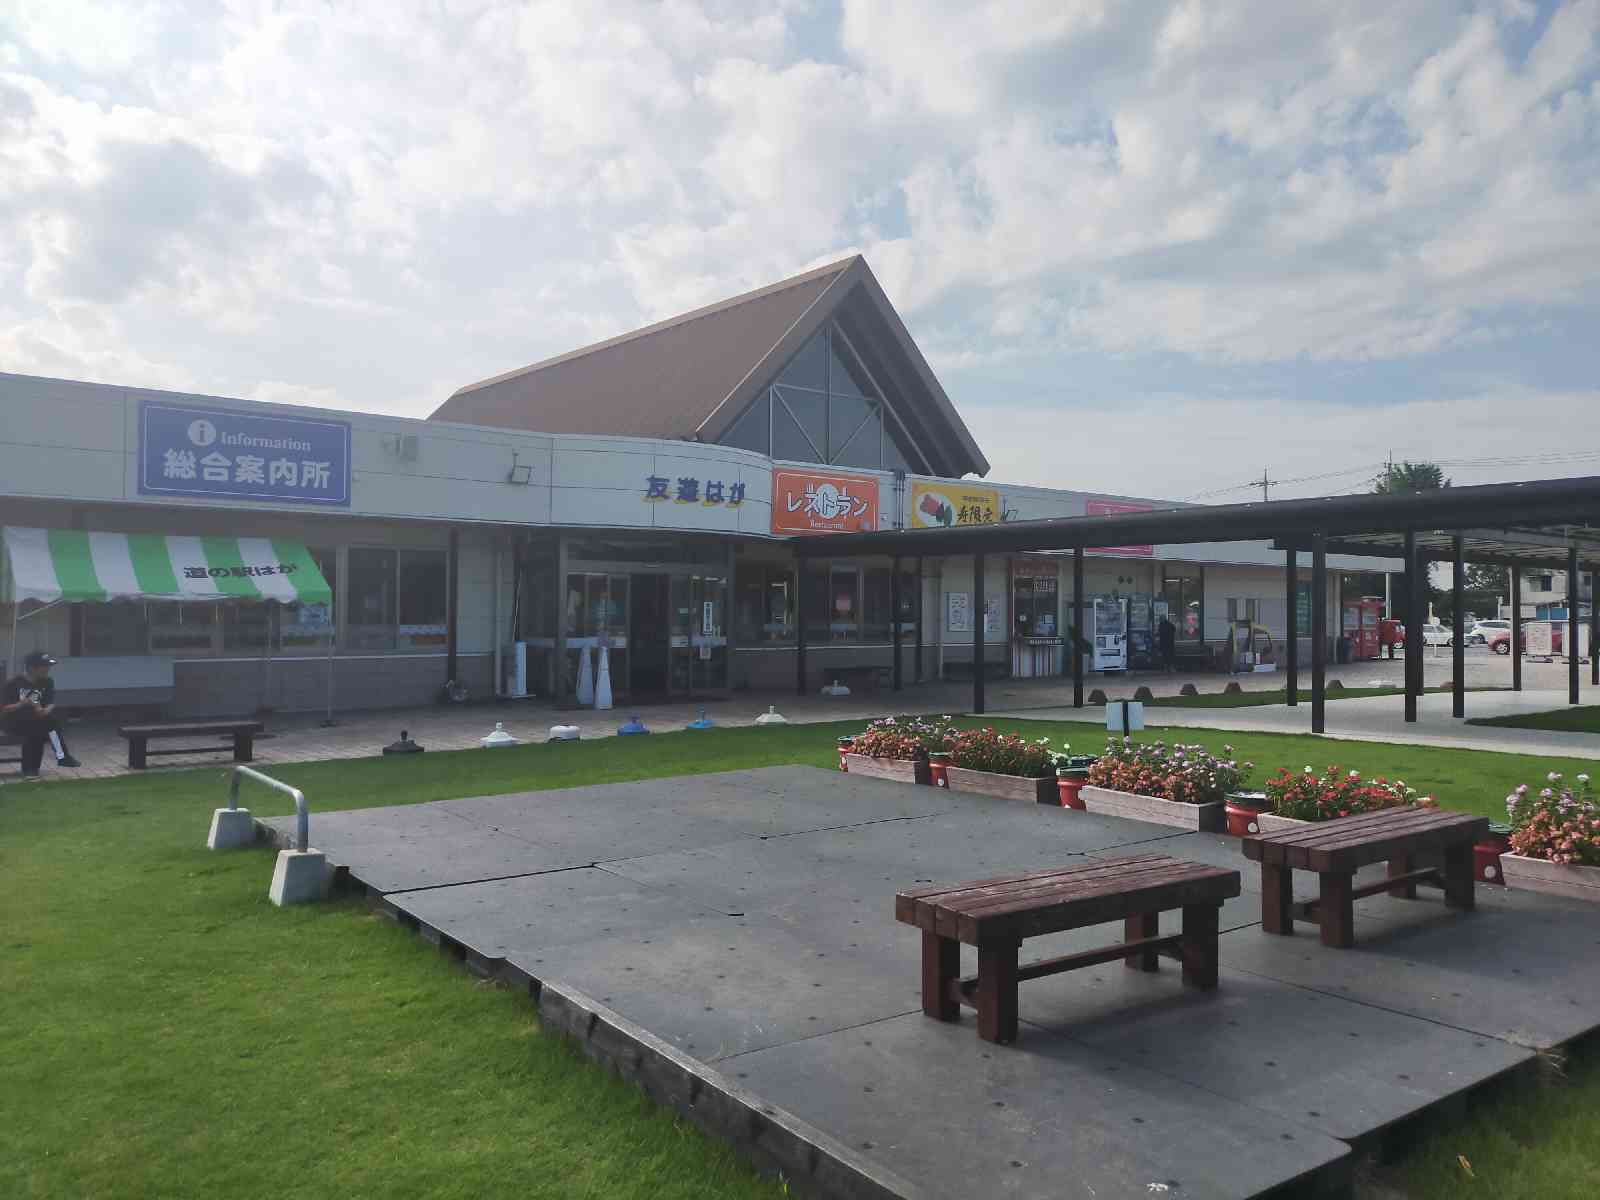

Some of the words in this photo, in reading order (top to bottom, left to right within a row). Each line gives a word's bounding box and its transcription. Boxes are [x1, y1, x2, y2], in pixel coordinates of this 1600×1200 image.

[221, 431, 312, 452] Information
[163, 447, 332, 489] 総合案内所
[787, 481, 869, 516] レストラン
[184, 563, 299, 578] 道の駅はが
